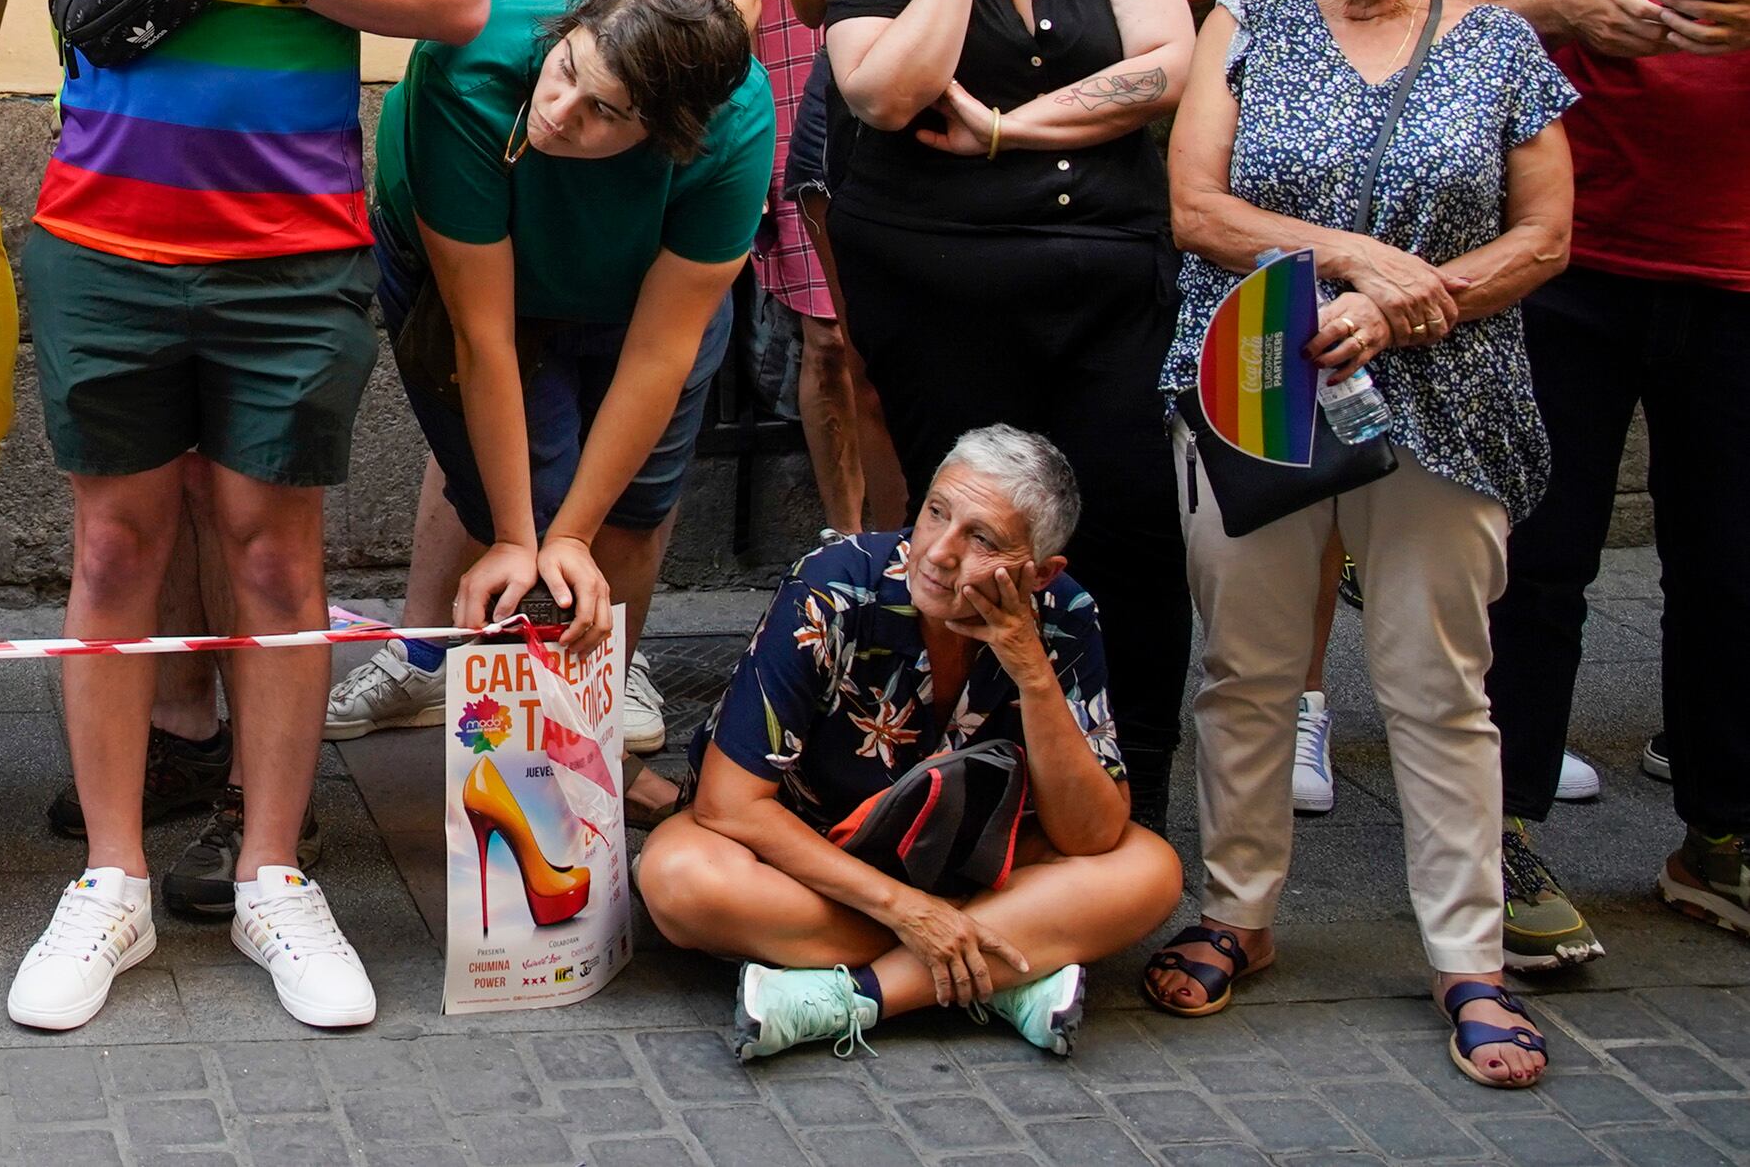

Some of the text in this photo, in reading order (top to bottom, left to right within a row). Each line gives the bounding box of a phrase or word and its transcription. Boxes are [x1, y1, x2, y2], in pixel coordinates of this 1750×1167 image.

[1273, 331, 1284, 387] PARTNERS
[468, 960, 511, 973] CHUMINA
[474, 977, 507, 989] POWER
